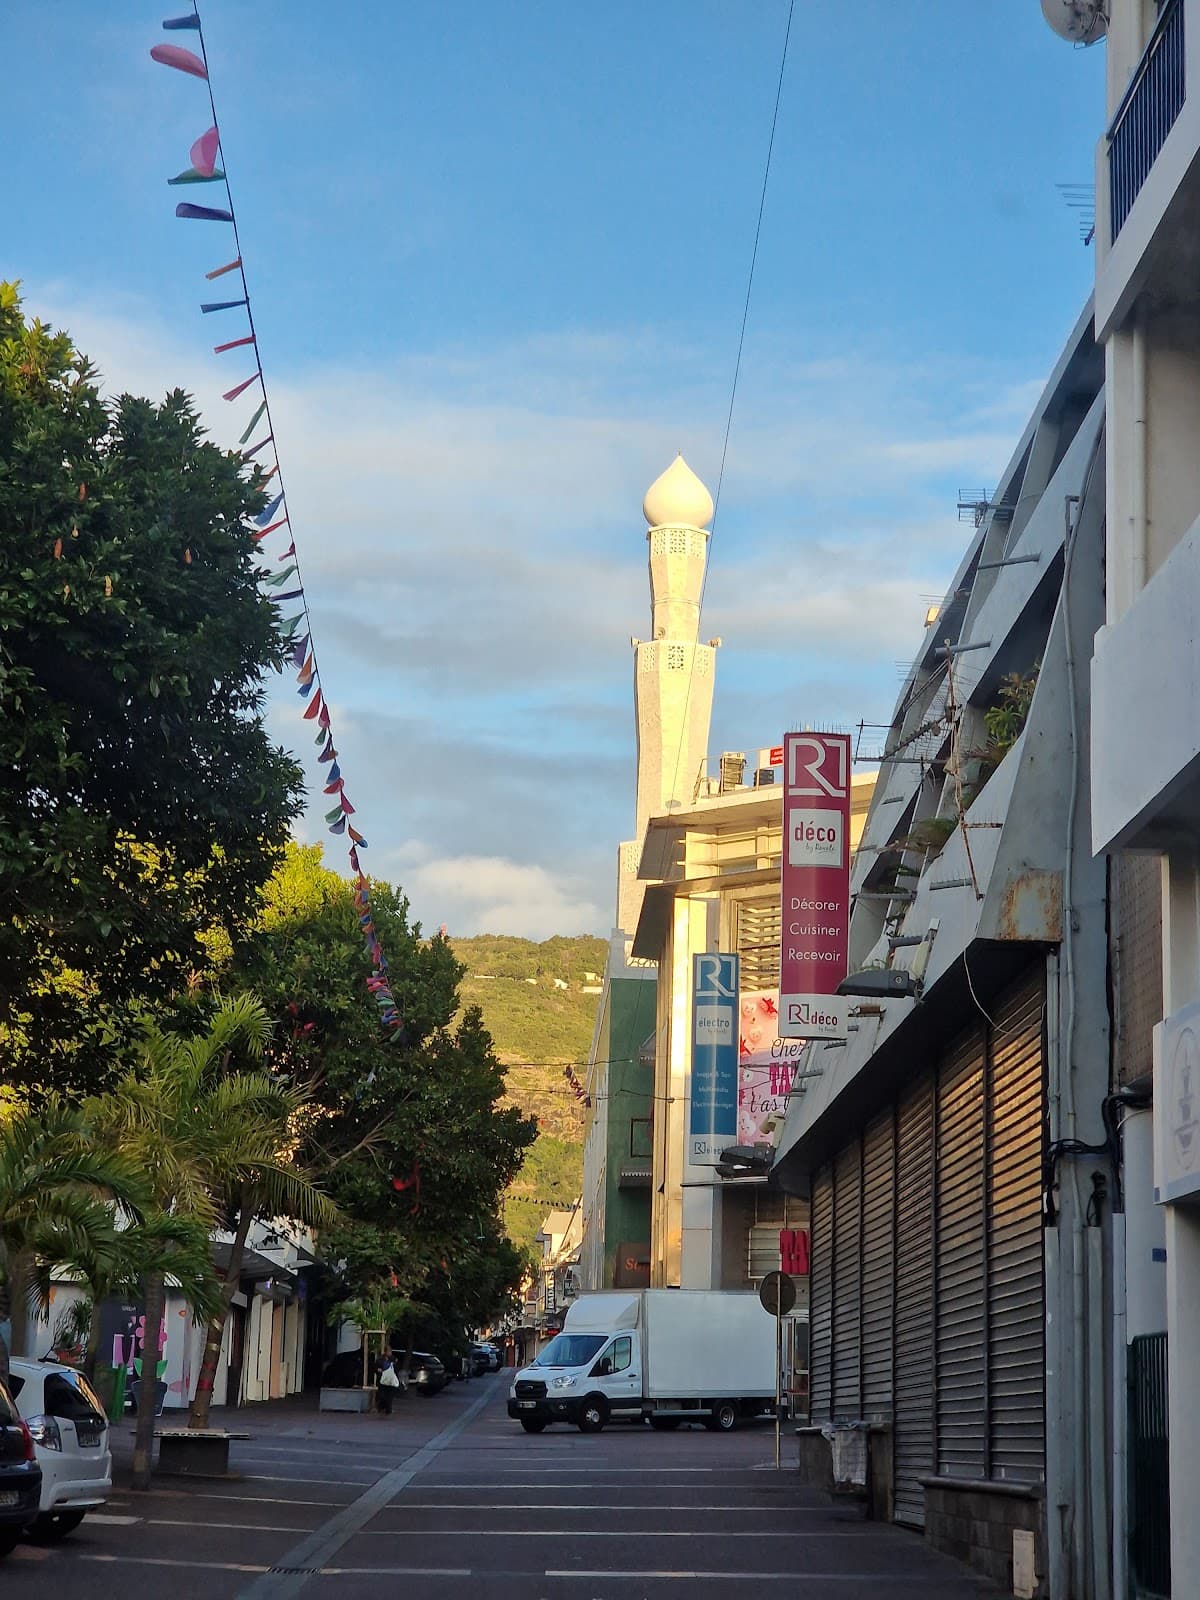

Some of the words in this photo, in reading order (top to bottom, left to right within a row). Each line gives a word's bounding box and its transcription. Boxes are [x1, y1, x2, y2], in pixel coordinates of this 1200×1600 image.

[794, 820, 836, 842] déco
[791, 897, 840, 912] Décorer
[789, 922, 841, 937] Cuisiner
[788, 948, 841, 962] Recevoir
[811, 1011, 838, 1026] déco
